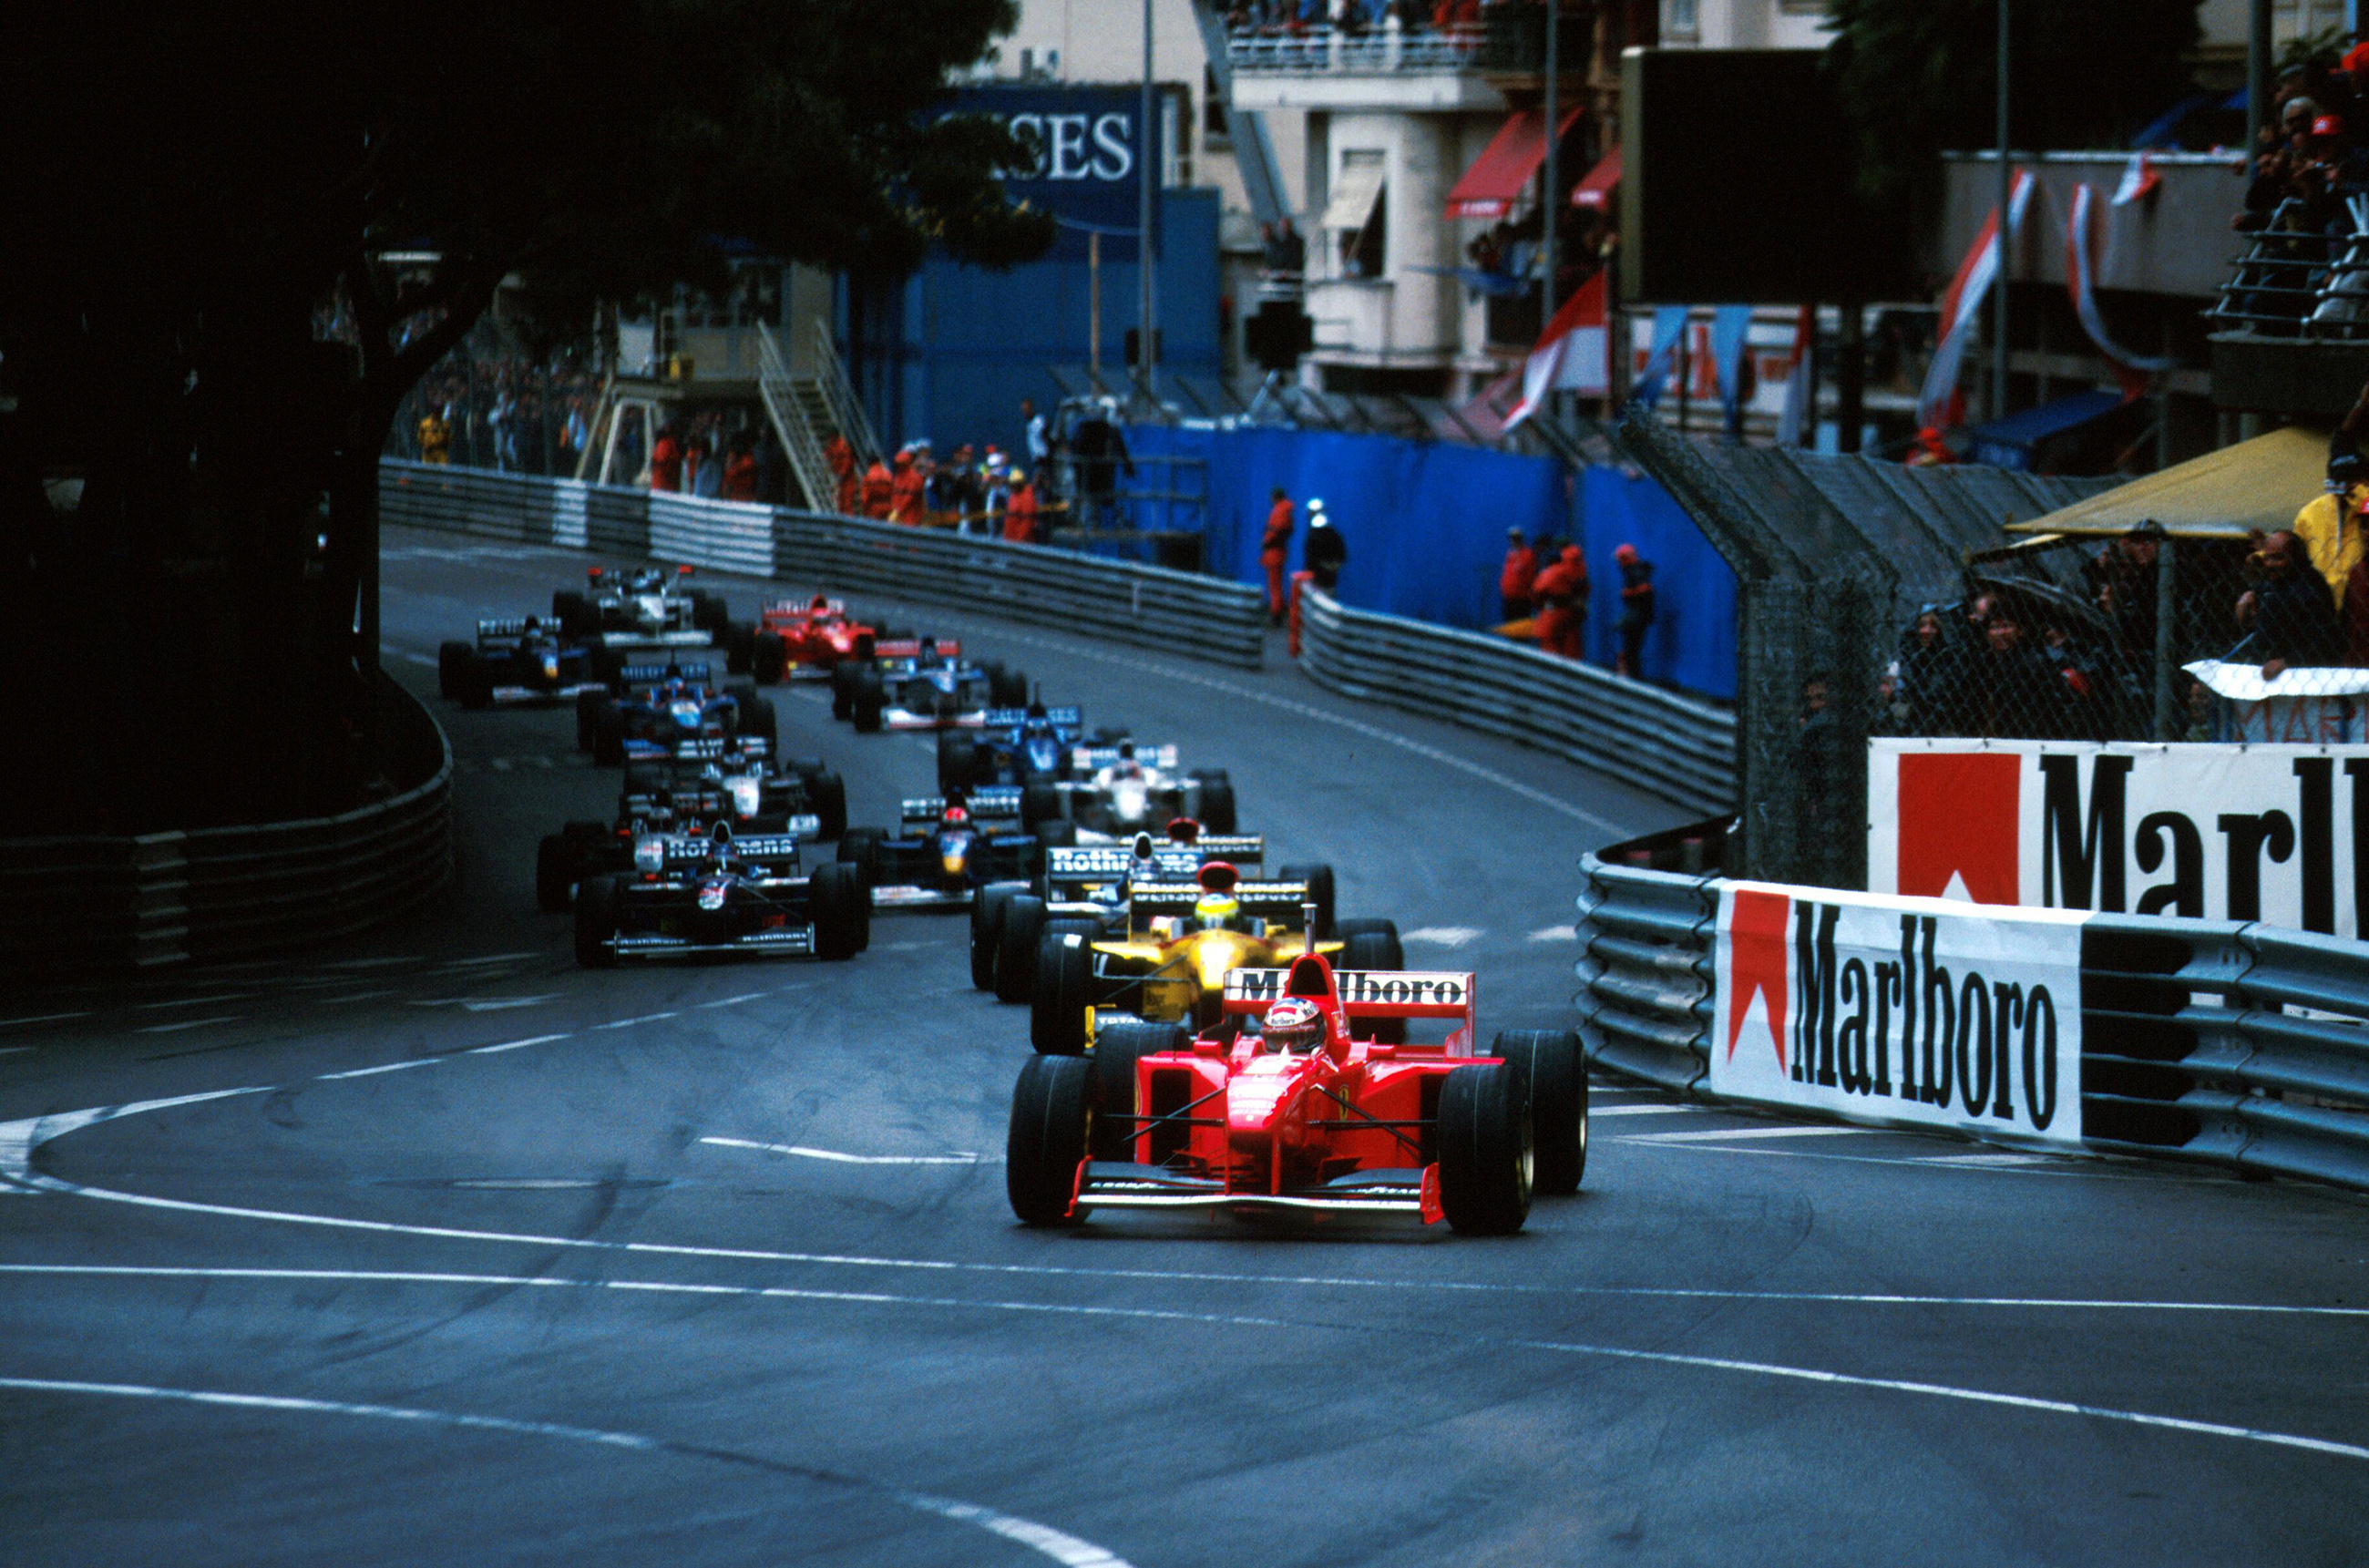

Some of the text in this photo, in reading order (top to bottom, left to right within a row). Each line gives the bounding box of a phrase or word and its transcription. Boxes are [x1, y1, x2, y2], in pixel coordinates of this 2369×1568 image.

[2230, 693, 2369, 743] MAR
[669, 838, 794, 858] Rotmans
[1053, 848, 1199, 872] Rothns
[1242, 972, 1462, 1005] Mlboro
[1098, 1016, 1144, 1024] TOTA
[1791, 901, 2057, 1131] Marlboro
